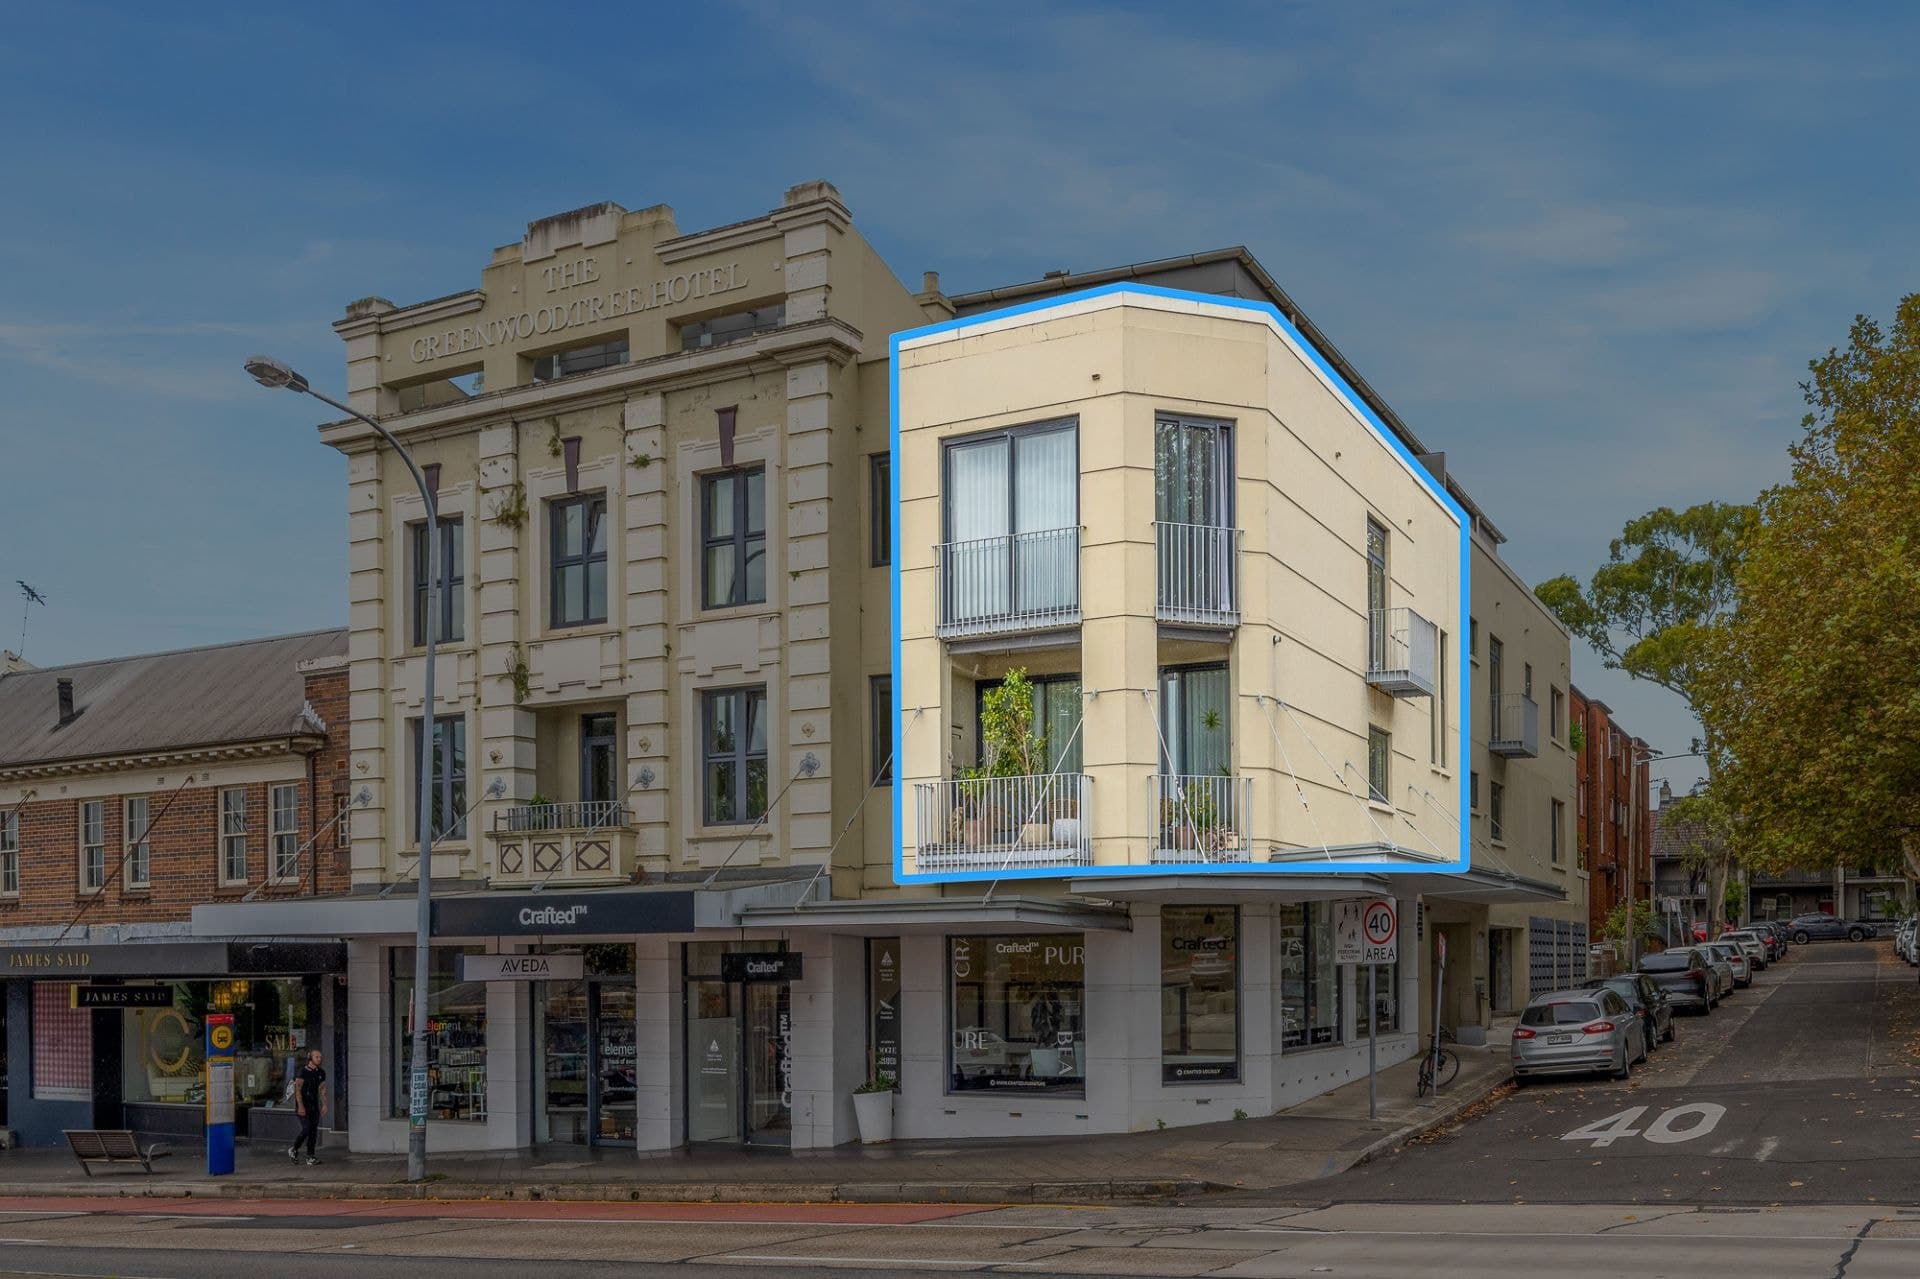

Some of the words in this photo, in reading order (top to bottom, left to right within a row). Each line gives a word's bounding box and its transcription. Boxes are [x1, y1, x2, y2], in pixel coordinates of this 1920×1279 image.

[543, 256, 600, 294] THE
[645, 263, 749, 311] HOTEL
[1368, 913, 1391, 933] 40
[9, 953, 51, 968] JAMES
[56, 952, 91, 967] SAID
[1366, 947, 1395, 961] AREA
[501, 959, 549, 972] AVEDA
[84, 992, 128, 1002] JAMES
[133, 991, 168, 1001] SAID
[1560, 1102, 1727, 1148] 40
